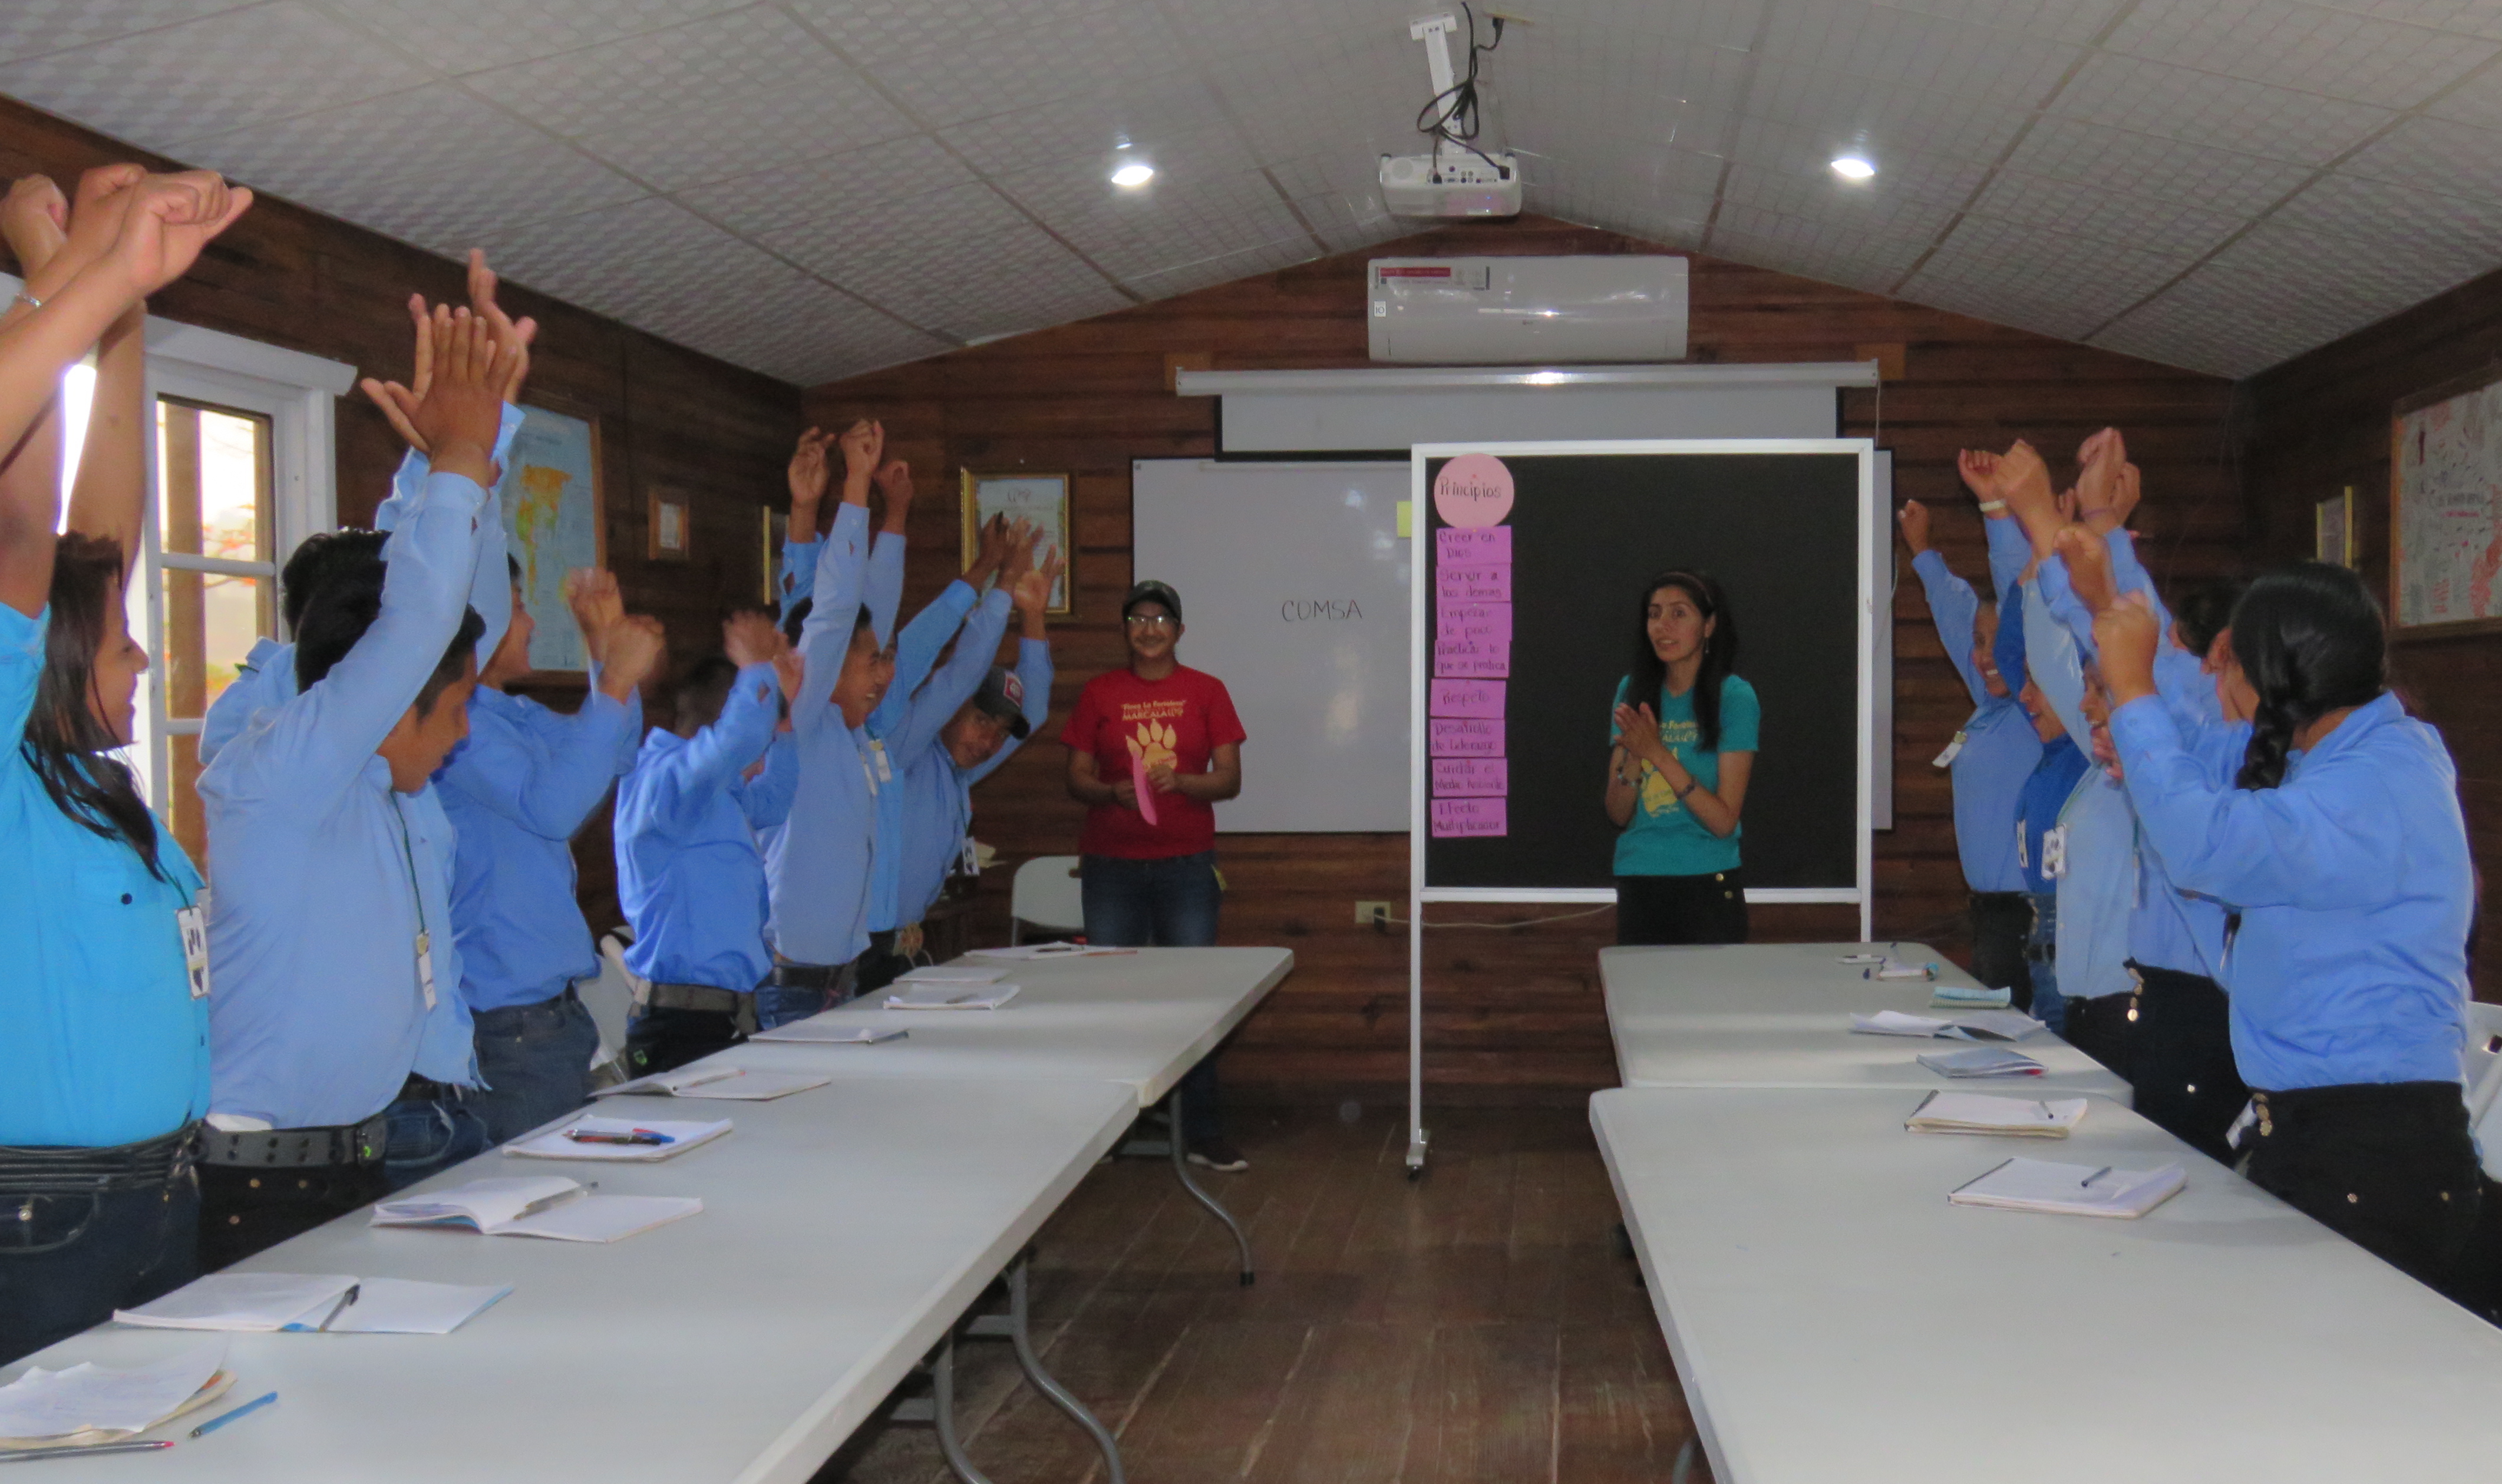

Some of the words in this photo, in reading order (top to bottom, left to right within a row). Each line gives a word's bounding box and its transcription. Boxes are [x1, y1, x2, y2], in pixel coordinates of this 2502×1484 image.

[1440, 477, 1501, 501] Principios
[1481, 533, 1496, 542] en
[1282, 599, 1362, 622] COMSA
